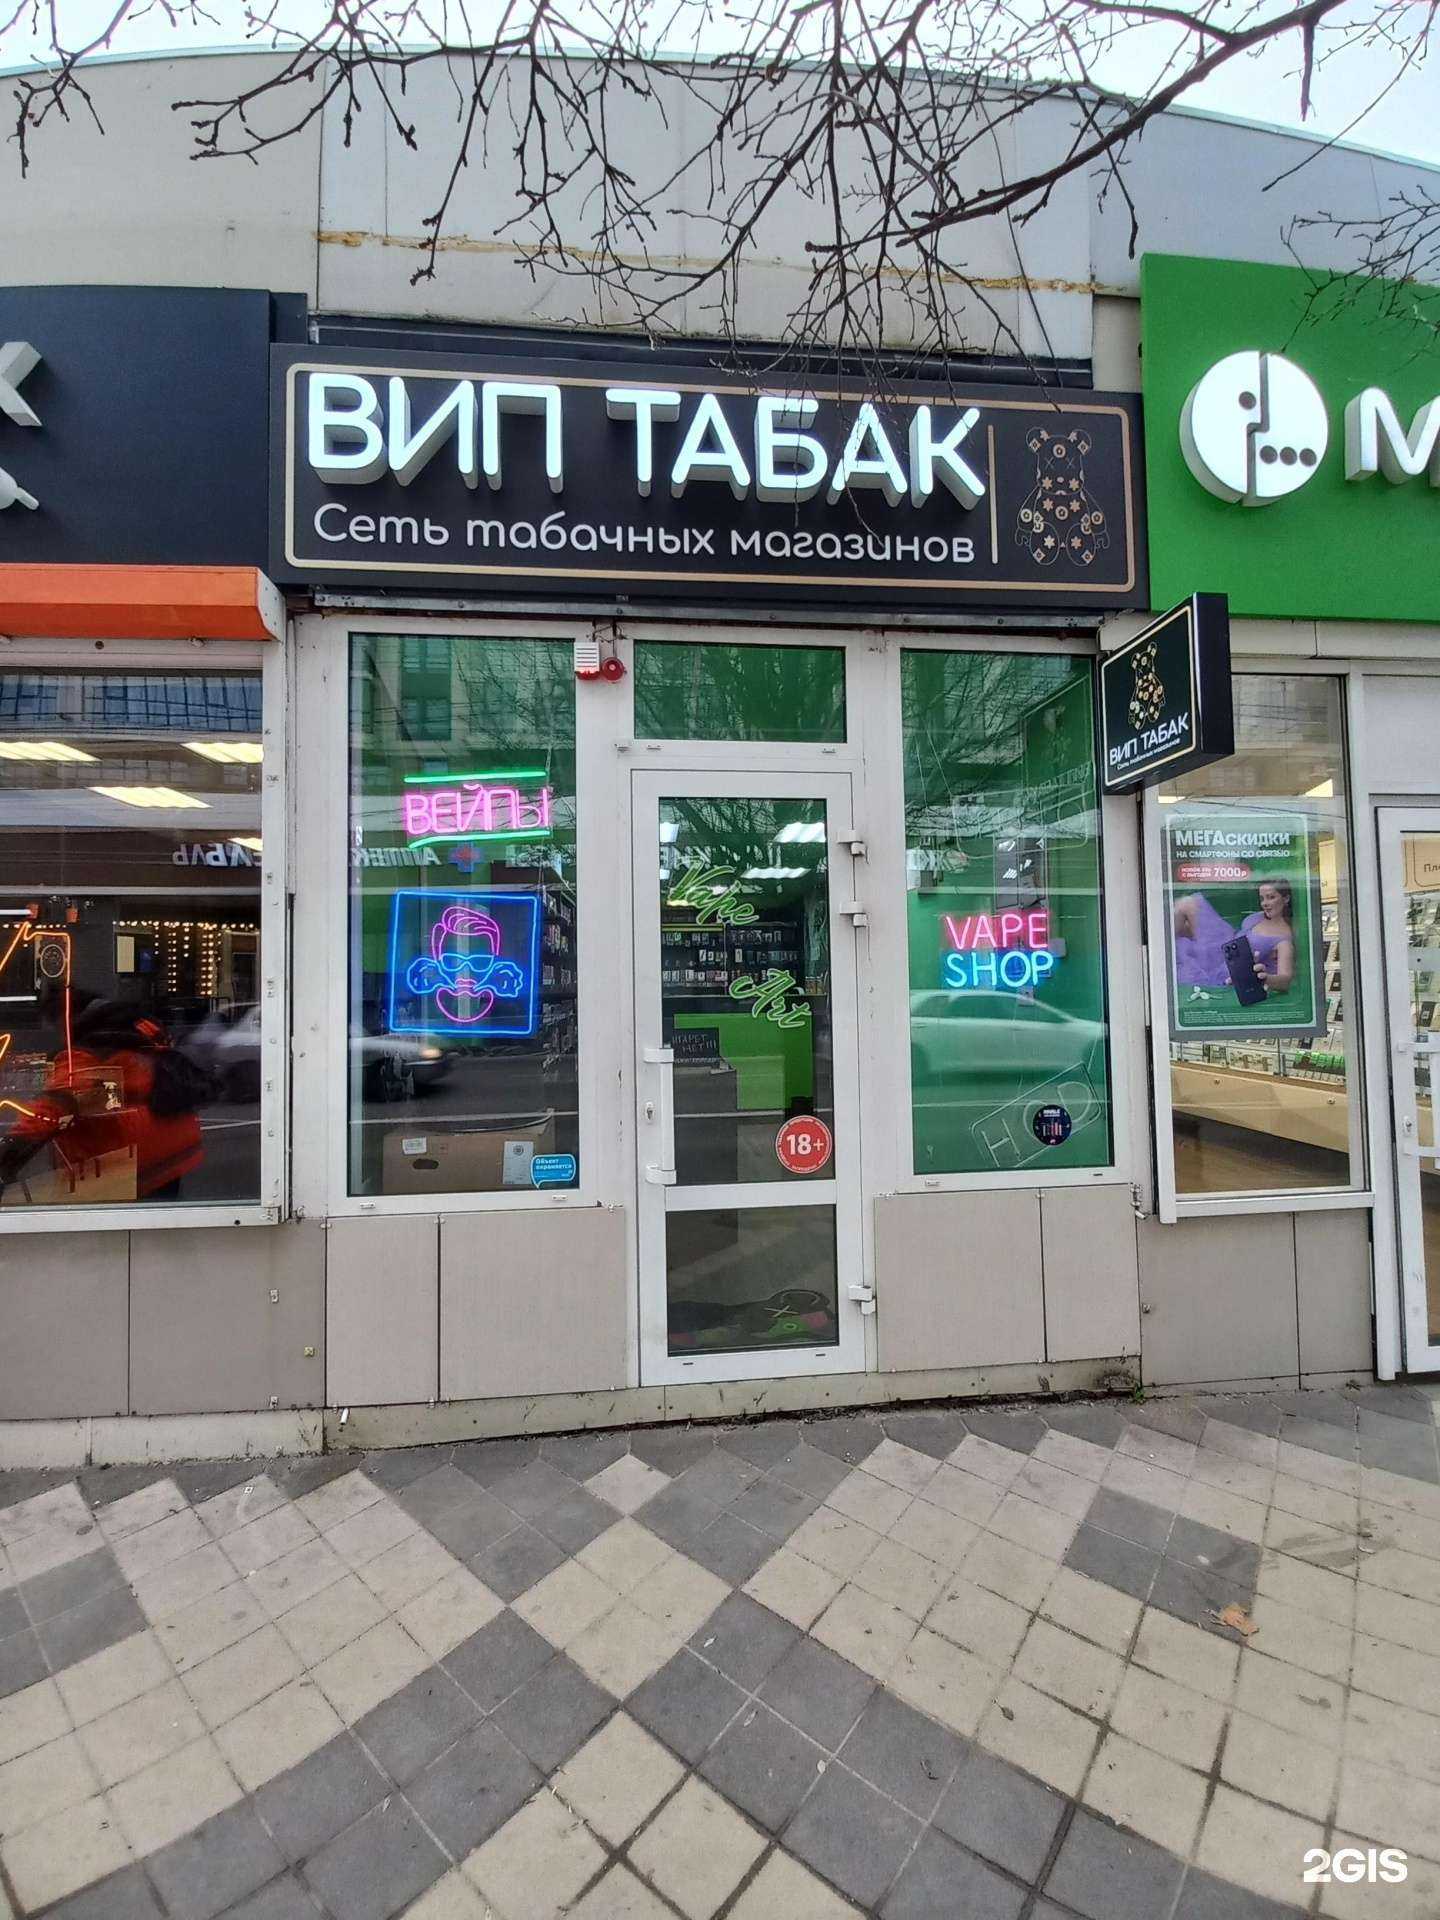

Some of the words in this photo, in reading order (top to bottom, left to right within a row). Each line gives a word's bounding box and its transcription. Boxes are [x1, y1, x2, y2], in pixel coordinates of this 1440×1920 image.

[309, 372, 562, 486] ВИП
[605, 388, 986, 504] ТАБАК
[313, 502, 450, 546] Сеть
[466, 510, 716, 556] табачных
[730, 528, 976, 564] магазинов
[1109, 738, 1138, 767] ВИП
[1140, 712, 1190, 751] ТАБАК
[405, 783, 550, 835] ВЕЙПЫ
[1176, 850, 1188, 859] НА
[945, 912, 1049, 951] VAPE
[945, 950, 1055, 988] SHOP
[786, 1133, 824, 1156] 18+
